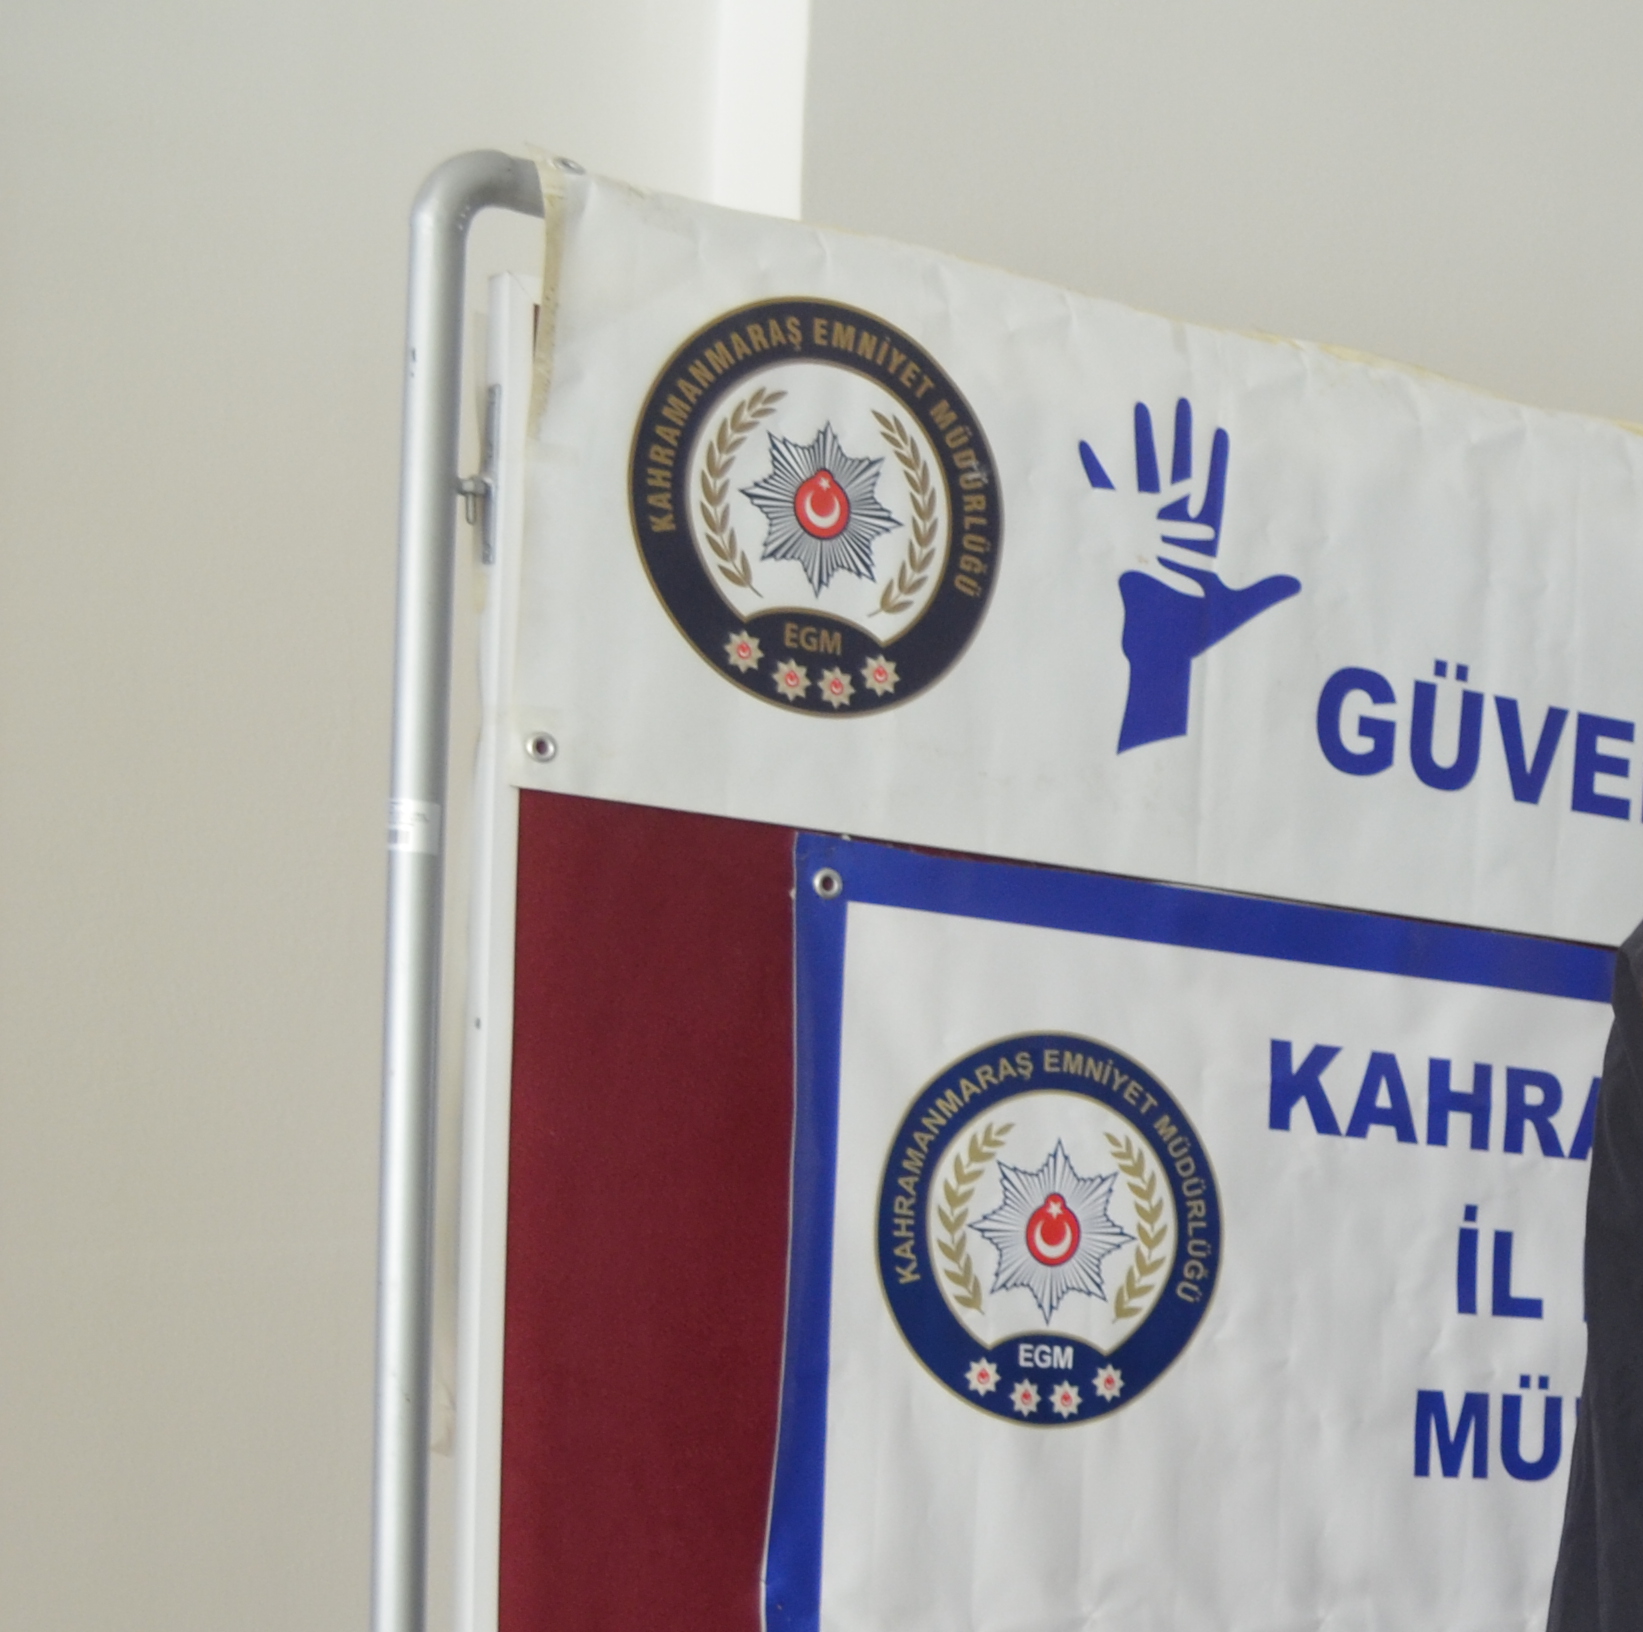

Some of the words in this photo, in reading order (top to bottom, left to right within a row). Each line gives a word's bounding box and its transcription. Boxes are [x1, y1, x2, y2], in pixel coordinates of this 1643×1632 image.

[646, 316, 804, 533] KAHRAMANMARAŞ
[812, 317, 934, 399] EMNİYET
[933, 398, 990, 599] MÜDÜRLÜĞÜ
[784, 623, 843, 656] EGM
[893, 1049, 1034, 1285] KAHRAMANMARAŞ
[1043, 1047, 1158, 1114] EMNİYET
[1153, 1113, 1208, 1306] MÜDÜRLÜĞÜ
[1456, 1204, 1544, 1320] İL
[1017, 1343, 1074, 1371] EGM
[1413, 1374, 1582, 1481] MÜ
